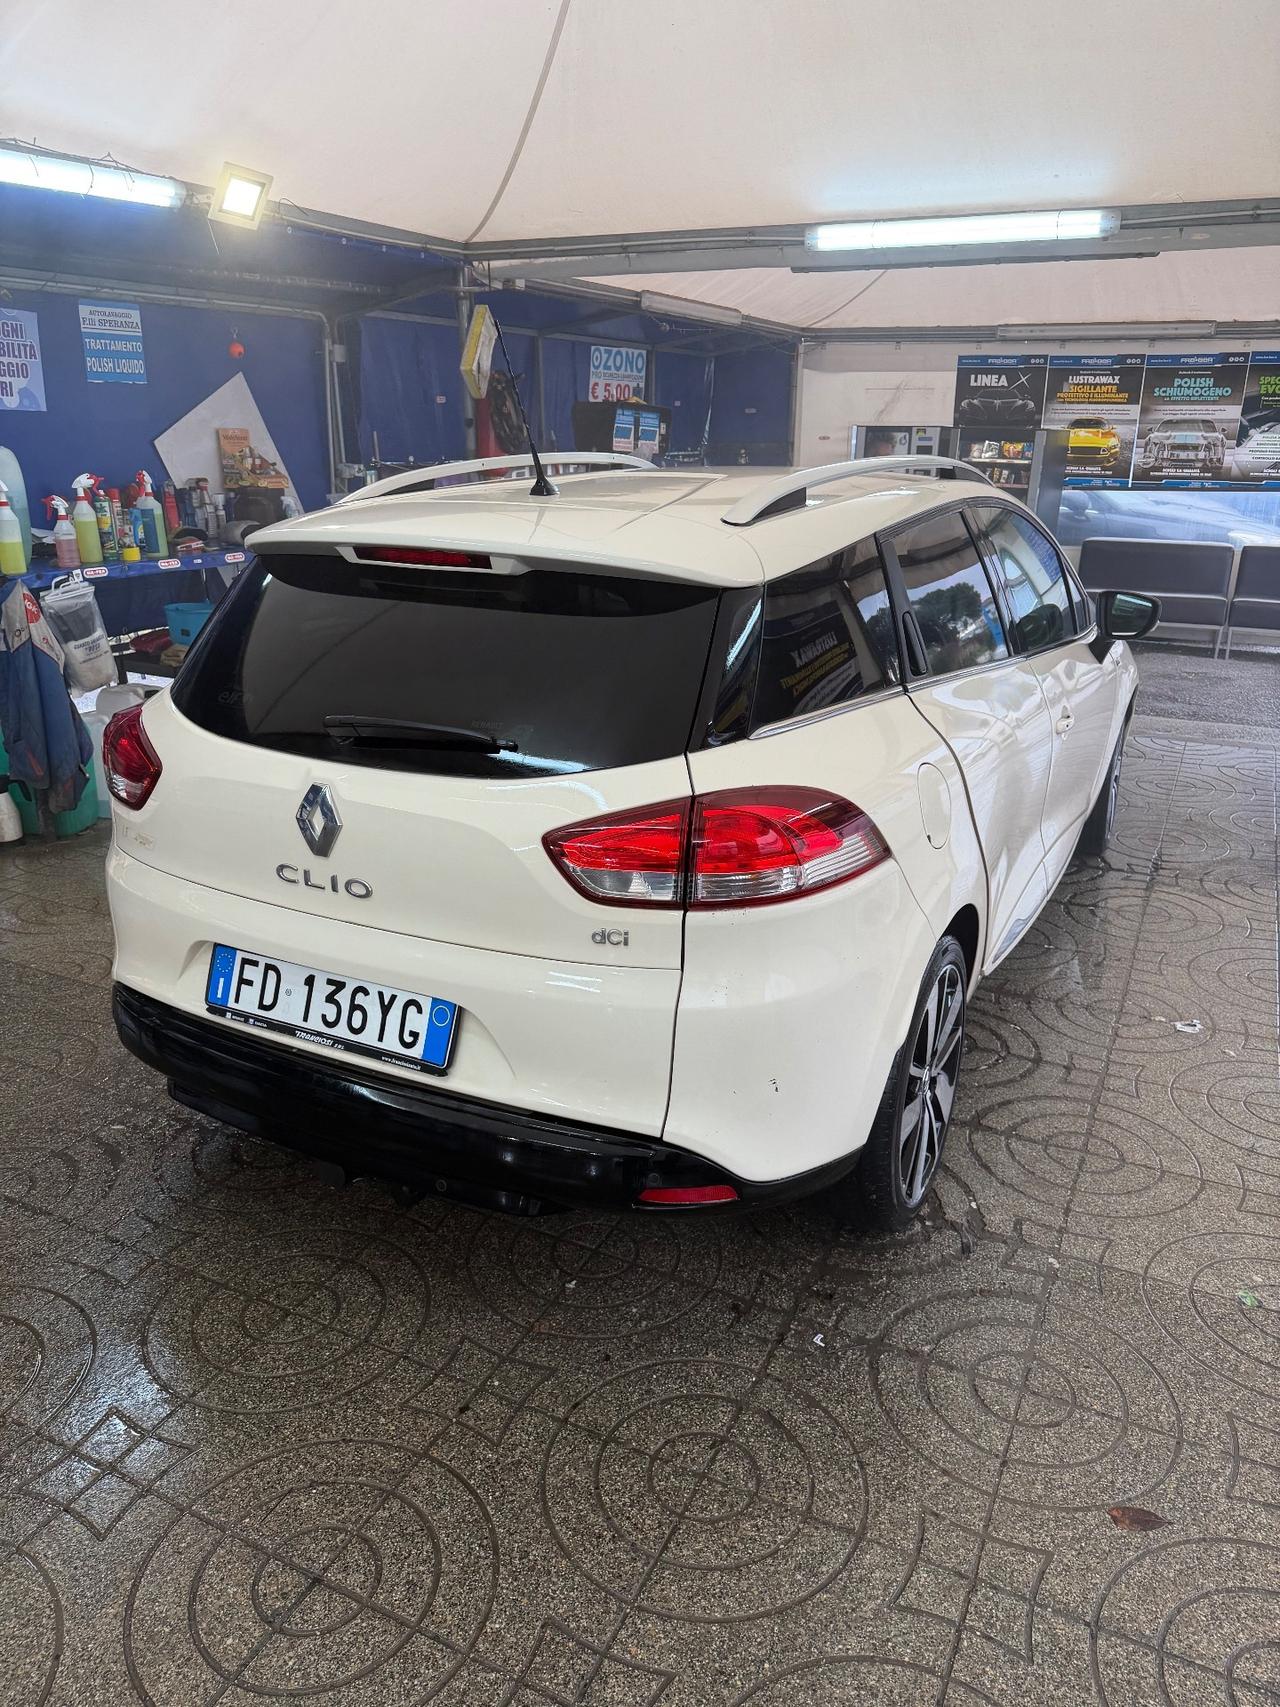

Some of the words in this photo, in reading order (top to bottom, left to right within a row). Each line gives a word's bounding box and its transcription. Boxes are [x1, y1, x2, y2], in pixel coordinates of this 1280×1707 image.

[88, 309, 133, 319] AUTOLAVAGGIO
[98, 318, 140, 330] SPERANZA
[84, 338, 143, 353] TRATTAMENTO
[86, 357, 114, 372] POLISH
[114, 359, 145, 374] LIQUIDO
[591, 347, 645, 374] OZONO
[970, 374, 1008, 387] LINEA
[1068, 375, 1120, 384] LUSTRAWAX
[1173, 377, 1214, 388] POLISH
[591, 382, 600, 400] €
[1069, 385, 1118, 393] SIGILLANTE
[1153, 387, 1232, 397] SCHIUMOGENO
[276, 863, 373, 899] CLIO
[591, 928, 629, 946] dCi
[234, 957, 282, 1012] FD
[302, 974, 423, 1049] 136YG
